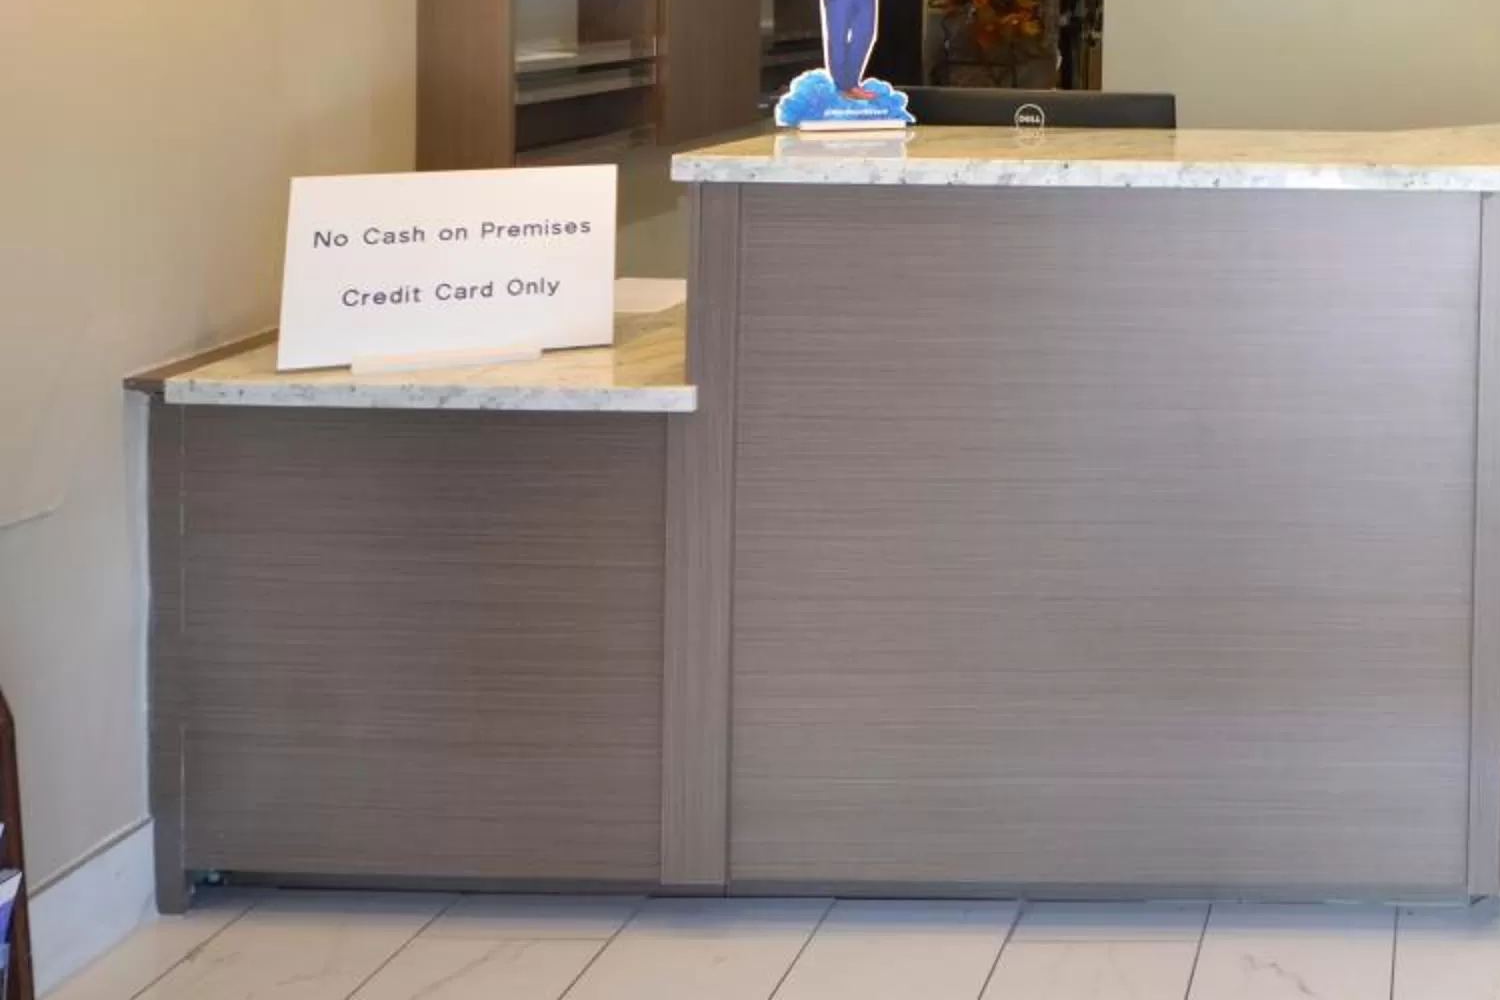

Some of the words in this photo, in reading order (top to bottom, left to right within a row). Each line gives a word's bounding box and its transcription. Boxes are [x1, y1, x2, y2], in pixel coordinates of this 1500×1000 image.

[1019, 114, 1041, 123] DELL
[313, 230, 349, 248] No
[363, 226, 425, 246] Cash
[438, 224, 468, 242] on
[481, 218, 592, 239] Premises
[341, 285, 422, 307] Credit
[435, 281, 494, 301] Card
[507, 277, 561, 298] Only
